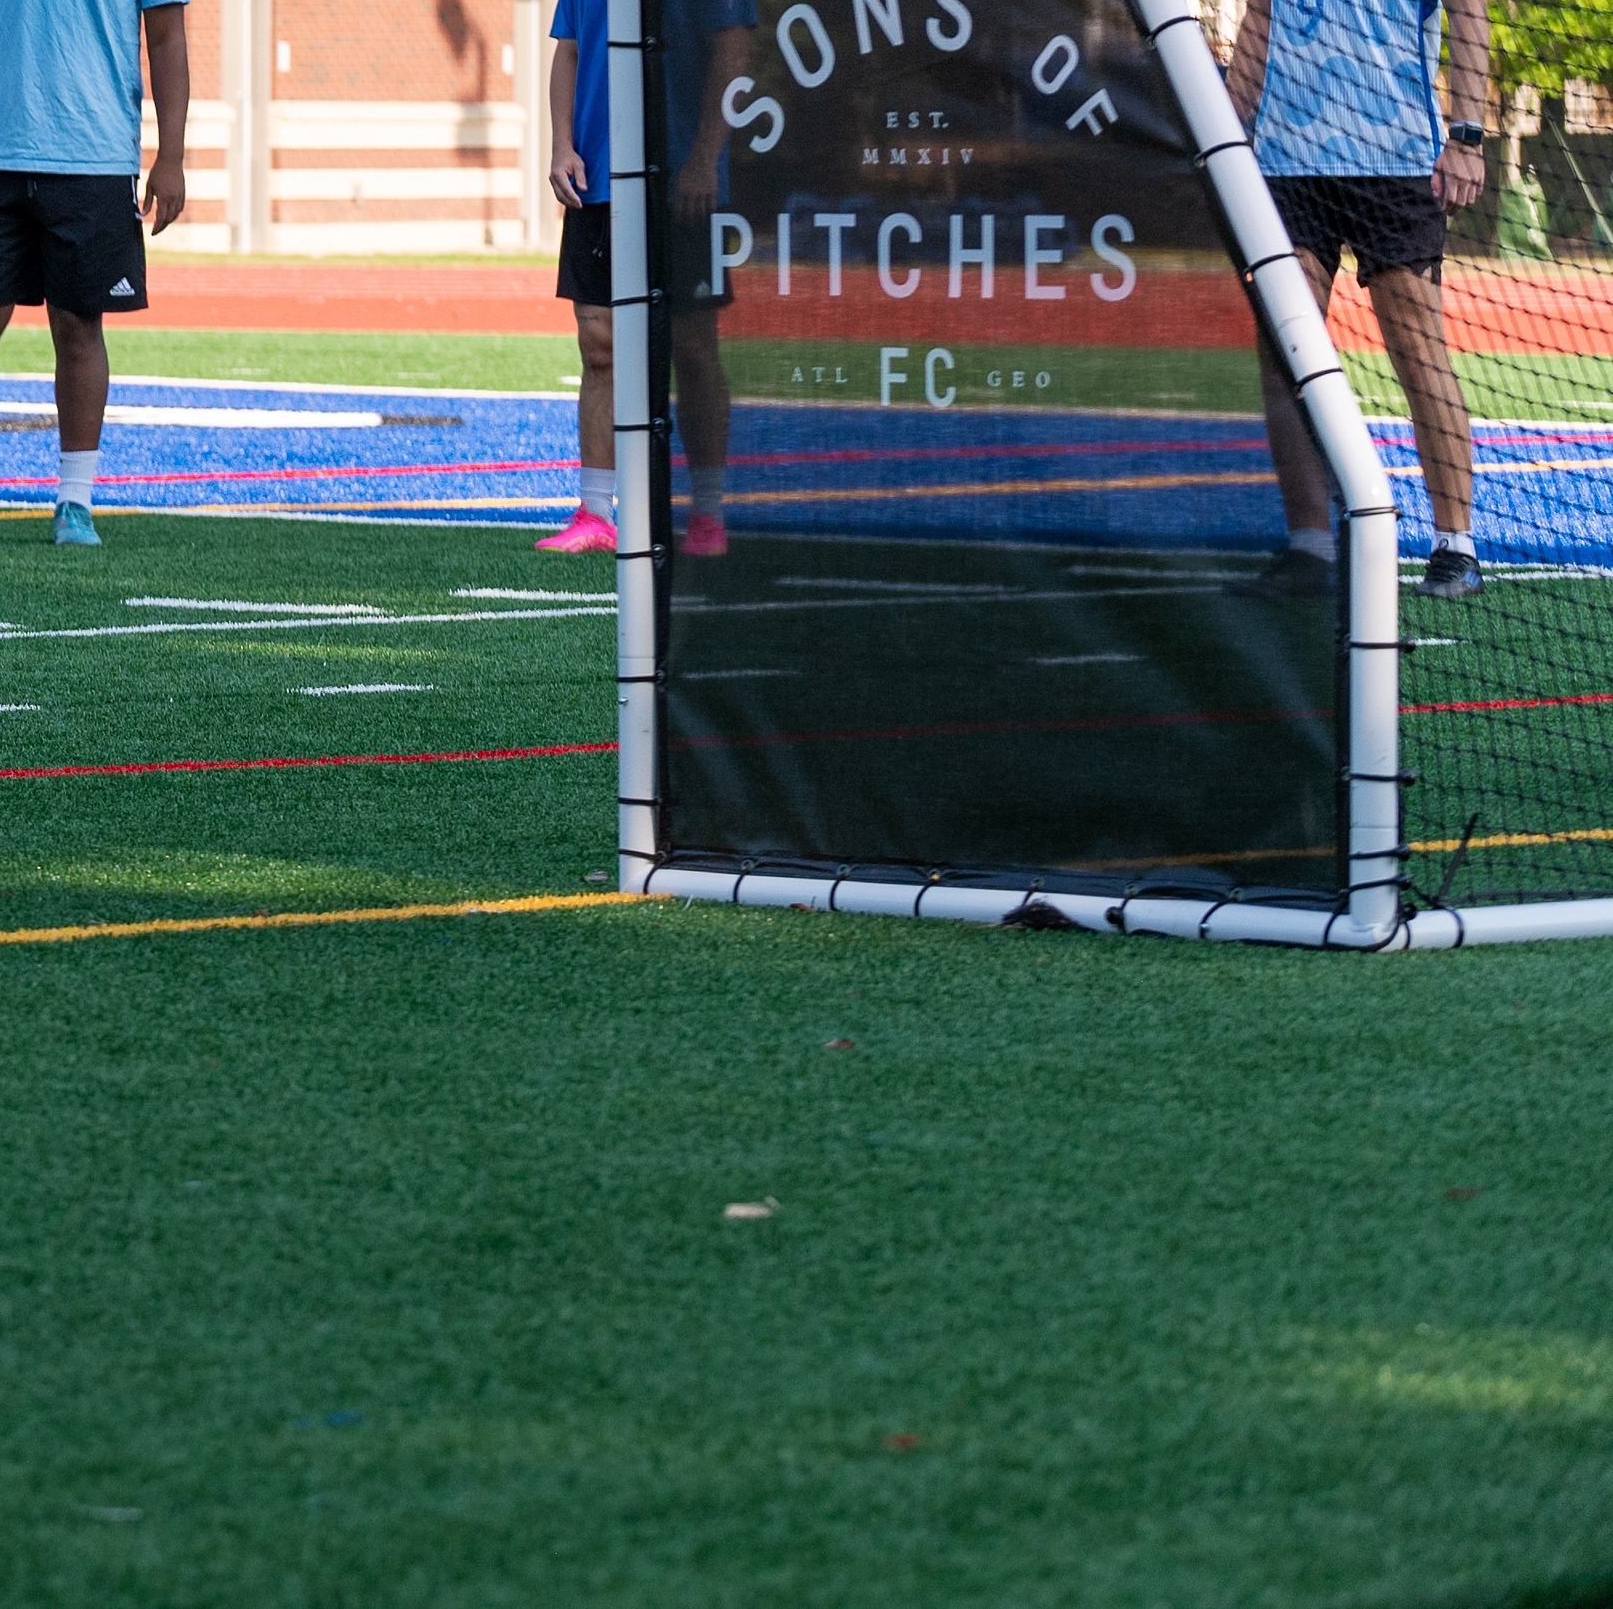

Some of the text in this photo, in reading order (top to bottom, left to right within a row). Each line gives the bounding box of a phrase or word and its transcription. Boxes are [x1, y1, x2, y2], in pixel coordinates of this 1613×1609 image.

[1030, 34, 1119, 136] OF
[885, 111, 950, 129] EST.
[862, 147, 974, 166] MMXIV
[710, 212, 1137, 301] PITCHES
[791, 347, 1052, 408] ATL FC GEO
